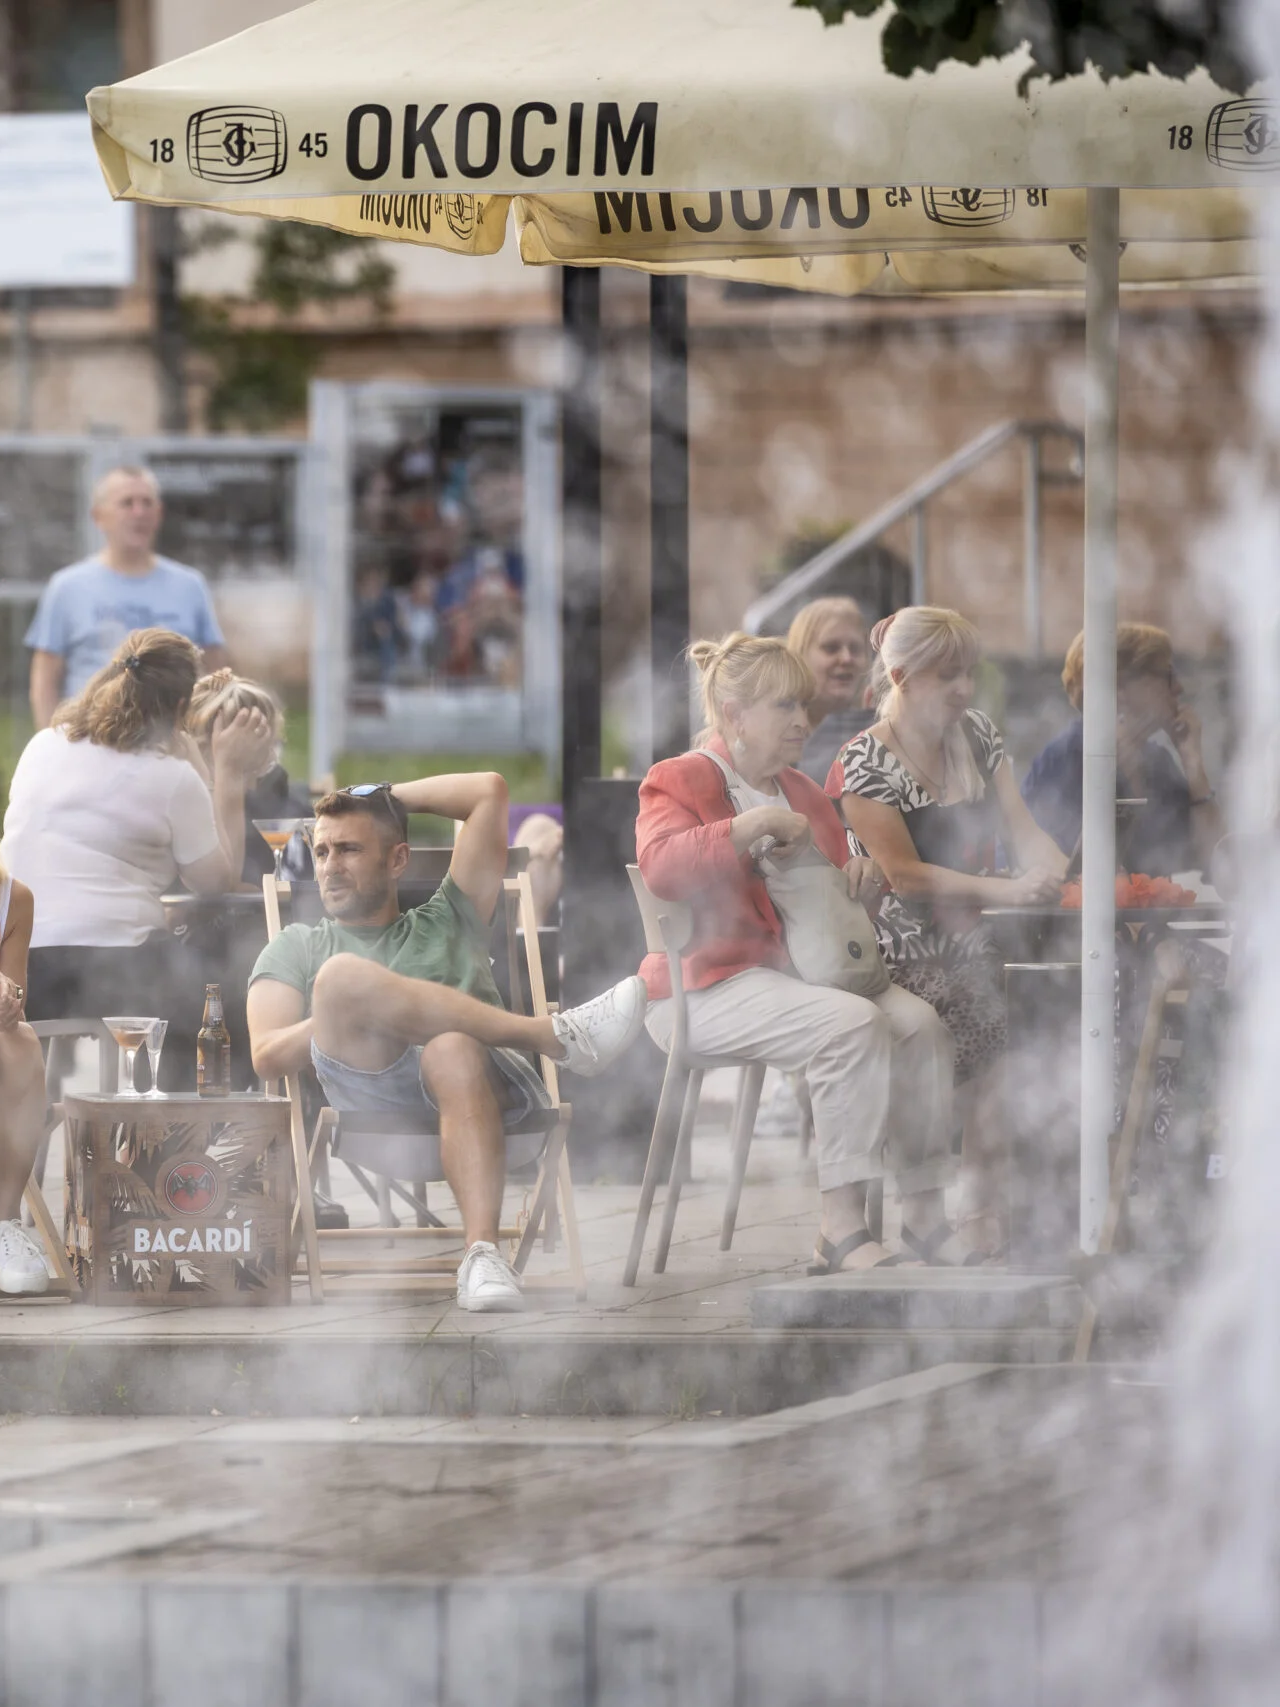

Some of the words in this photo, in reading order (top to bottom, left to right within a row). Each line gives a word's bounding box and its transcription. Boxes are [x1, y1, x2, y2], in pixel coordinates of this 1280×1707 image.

[148, 137, 174, 165] 18
[297, 131, 329, 160] 45
[345, 101, 659, 182] OKOCIM
[1167, 124, 1194, 151] 18
[133, 1219, 253, 1253] BACARDÍ
